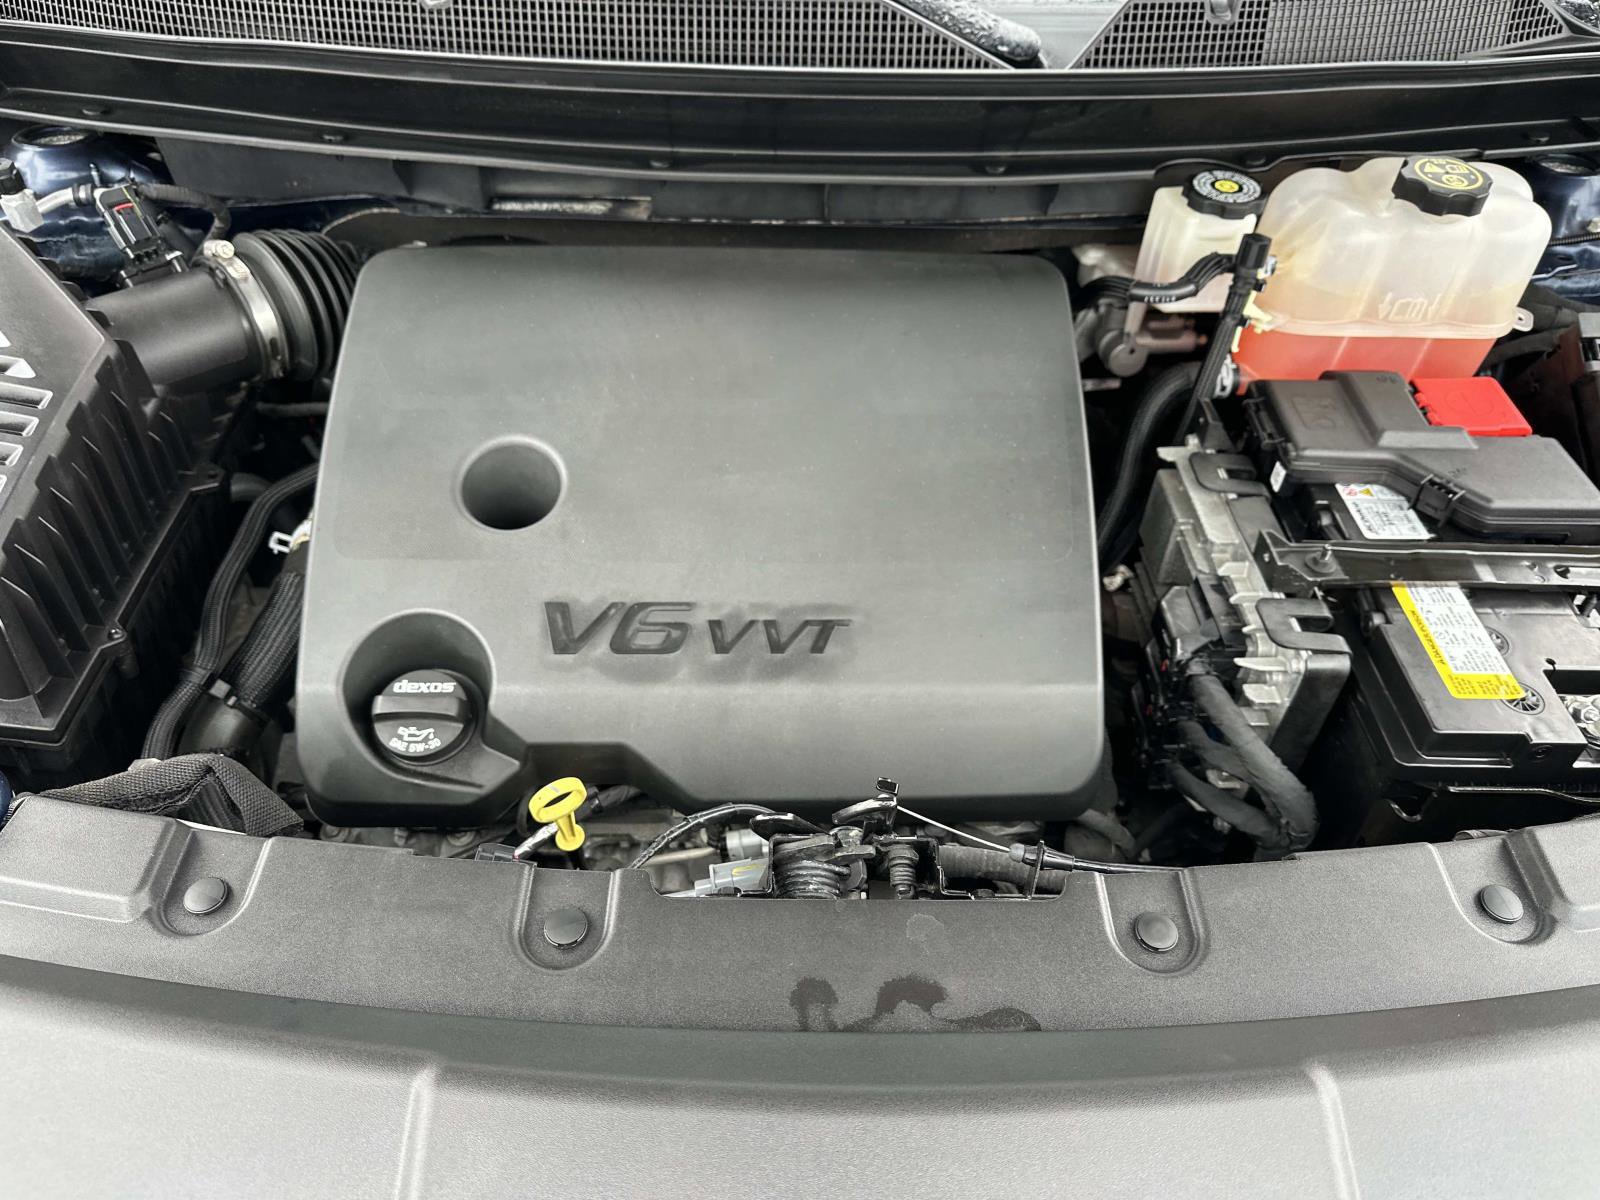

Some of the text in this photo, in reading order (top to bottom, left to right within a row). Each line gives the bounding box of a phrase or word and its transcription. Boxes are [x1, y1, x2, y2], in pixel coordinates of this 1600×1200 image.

[545, 601, 852, 654] V6 VVT
[393, 679, 456, 693] dexos
[388, 737, 441, 752] SAE 5W-30
